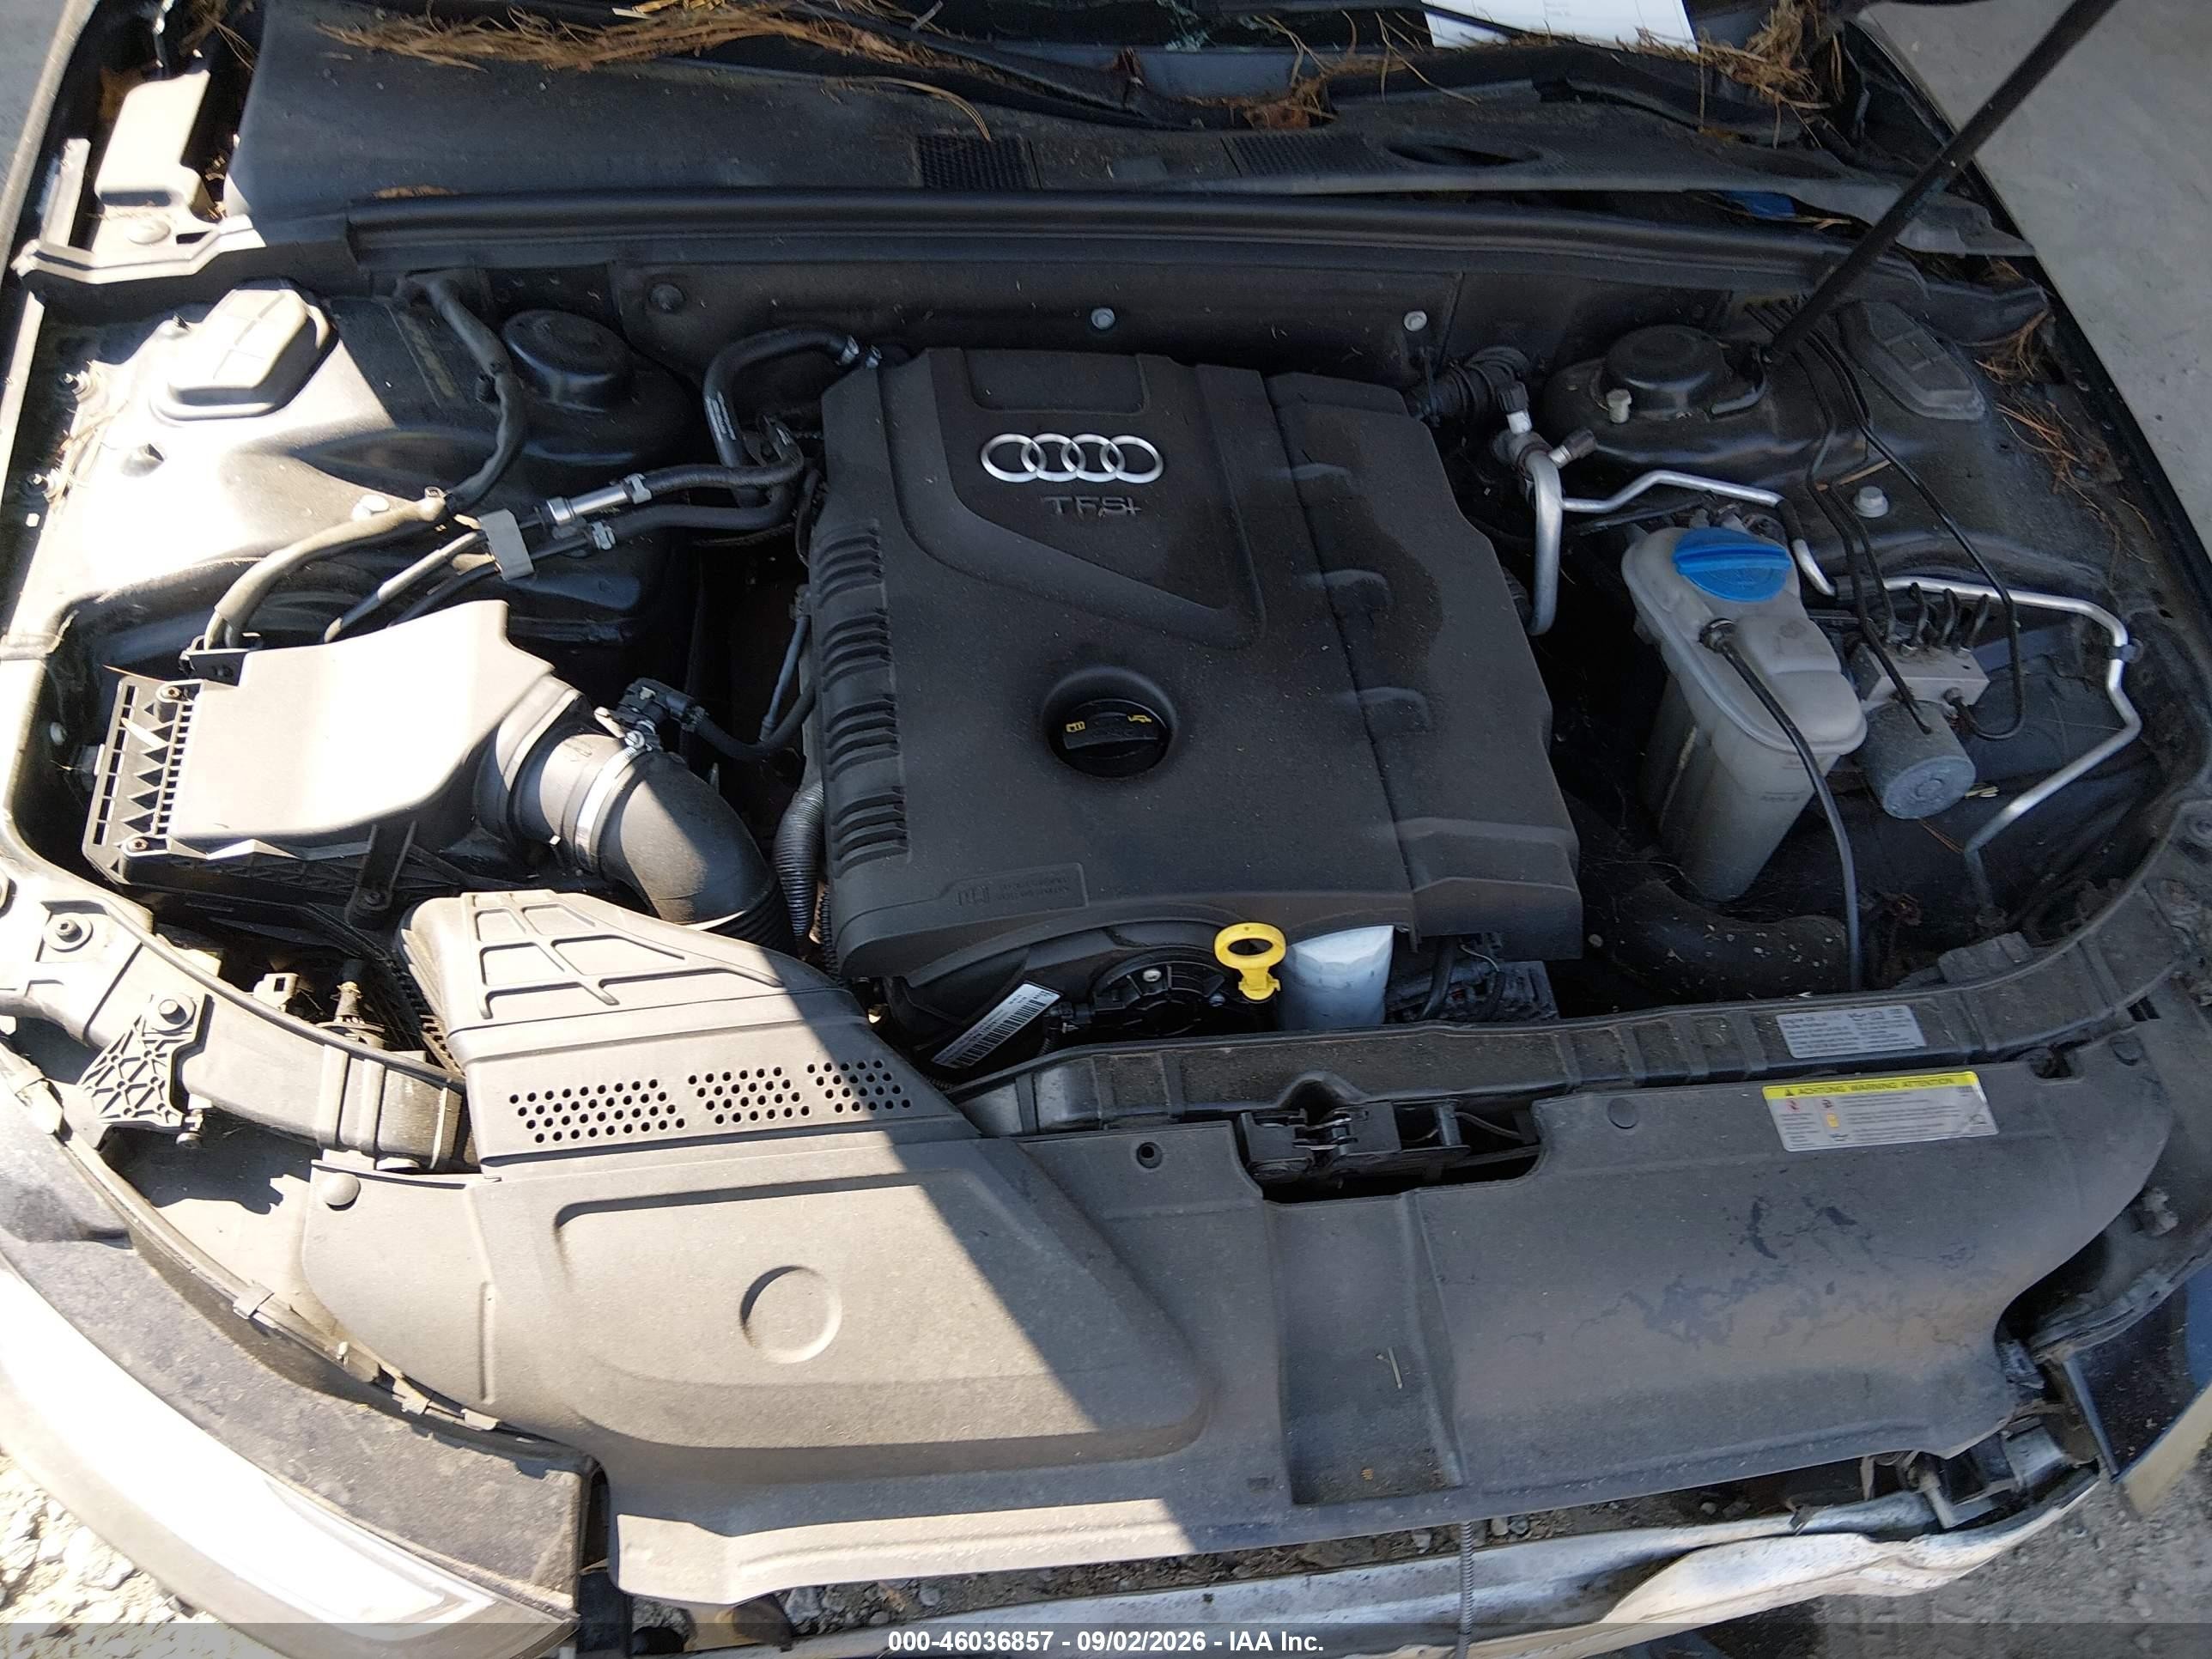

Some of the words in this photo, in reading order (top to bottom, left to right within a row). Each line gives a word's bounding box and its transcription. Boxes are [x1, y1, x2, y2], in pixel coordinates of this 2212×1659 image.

[1798, 1085, 1847, 1095] ACHTUNG
[1850, 1081, 1898, 1091] WARNING
[1902, 1078, 1955, 1088] ATTENTION
